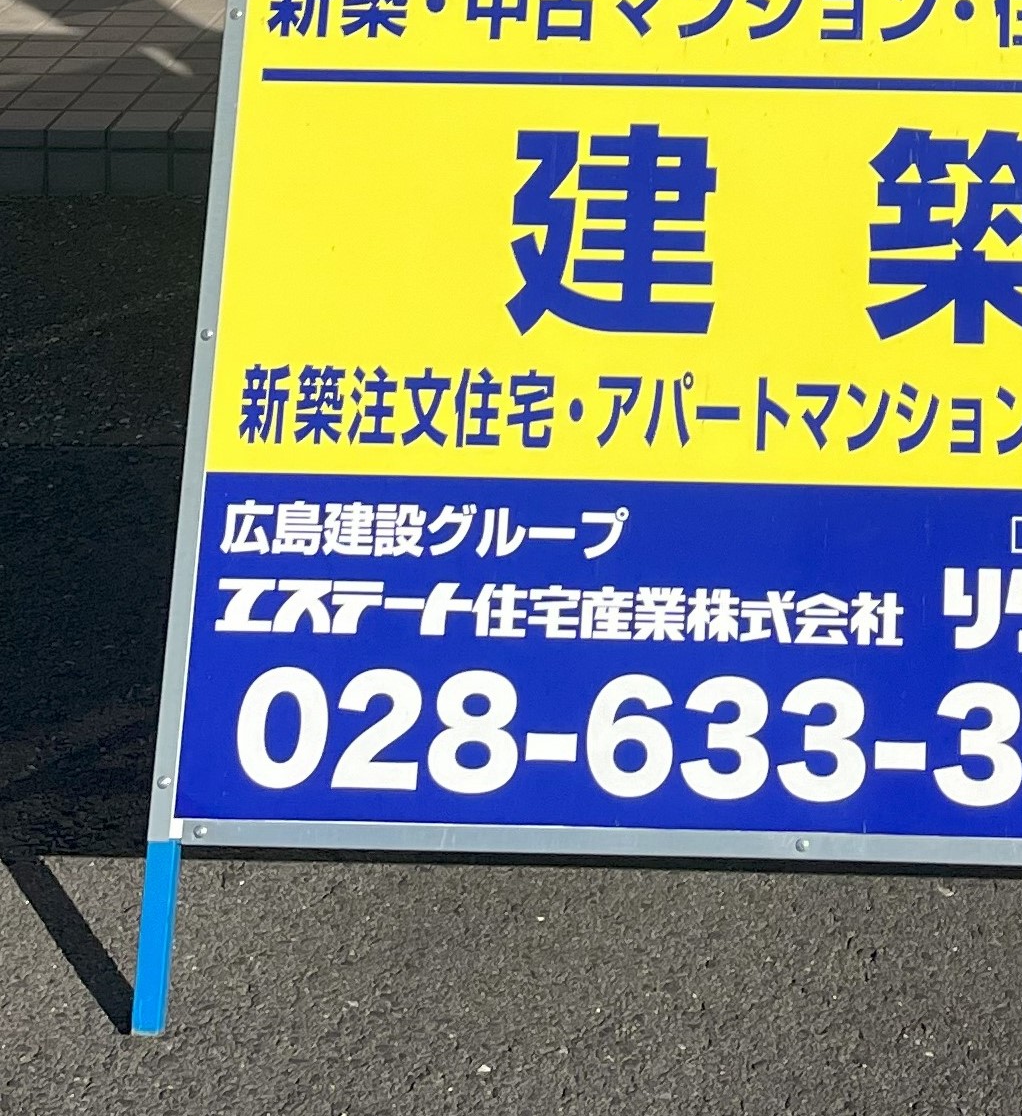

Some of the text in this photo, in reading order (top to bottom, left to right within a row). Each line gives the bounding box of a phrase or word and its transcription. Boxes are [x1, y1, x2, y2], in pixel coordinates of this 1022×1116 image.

[220, 500, 630, 560] 広島建設グループ
[214, 577, 904, 648] エステート住宅産業株式会社
